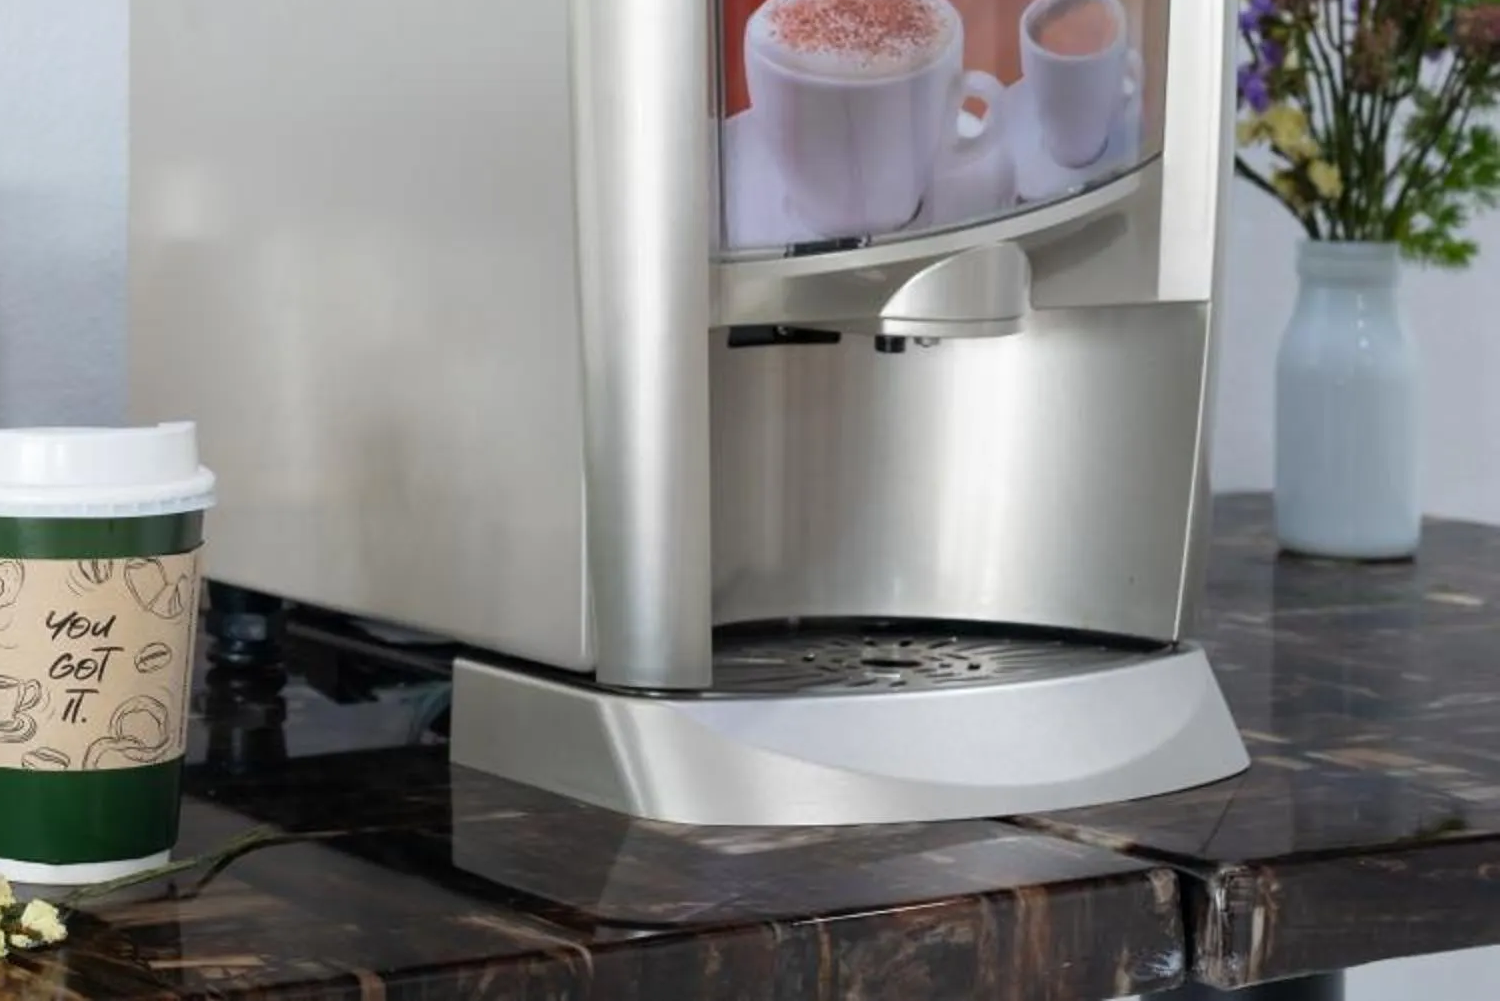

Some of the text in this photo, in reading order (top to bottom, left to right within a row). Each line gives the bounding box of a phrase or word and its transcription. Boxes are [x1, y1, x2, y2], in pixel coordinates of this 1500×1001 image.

[45, 610, 117, 641] YOU
[48, 646, 125, 683] GOT
[62, 689, 100, 724] IT.
